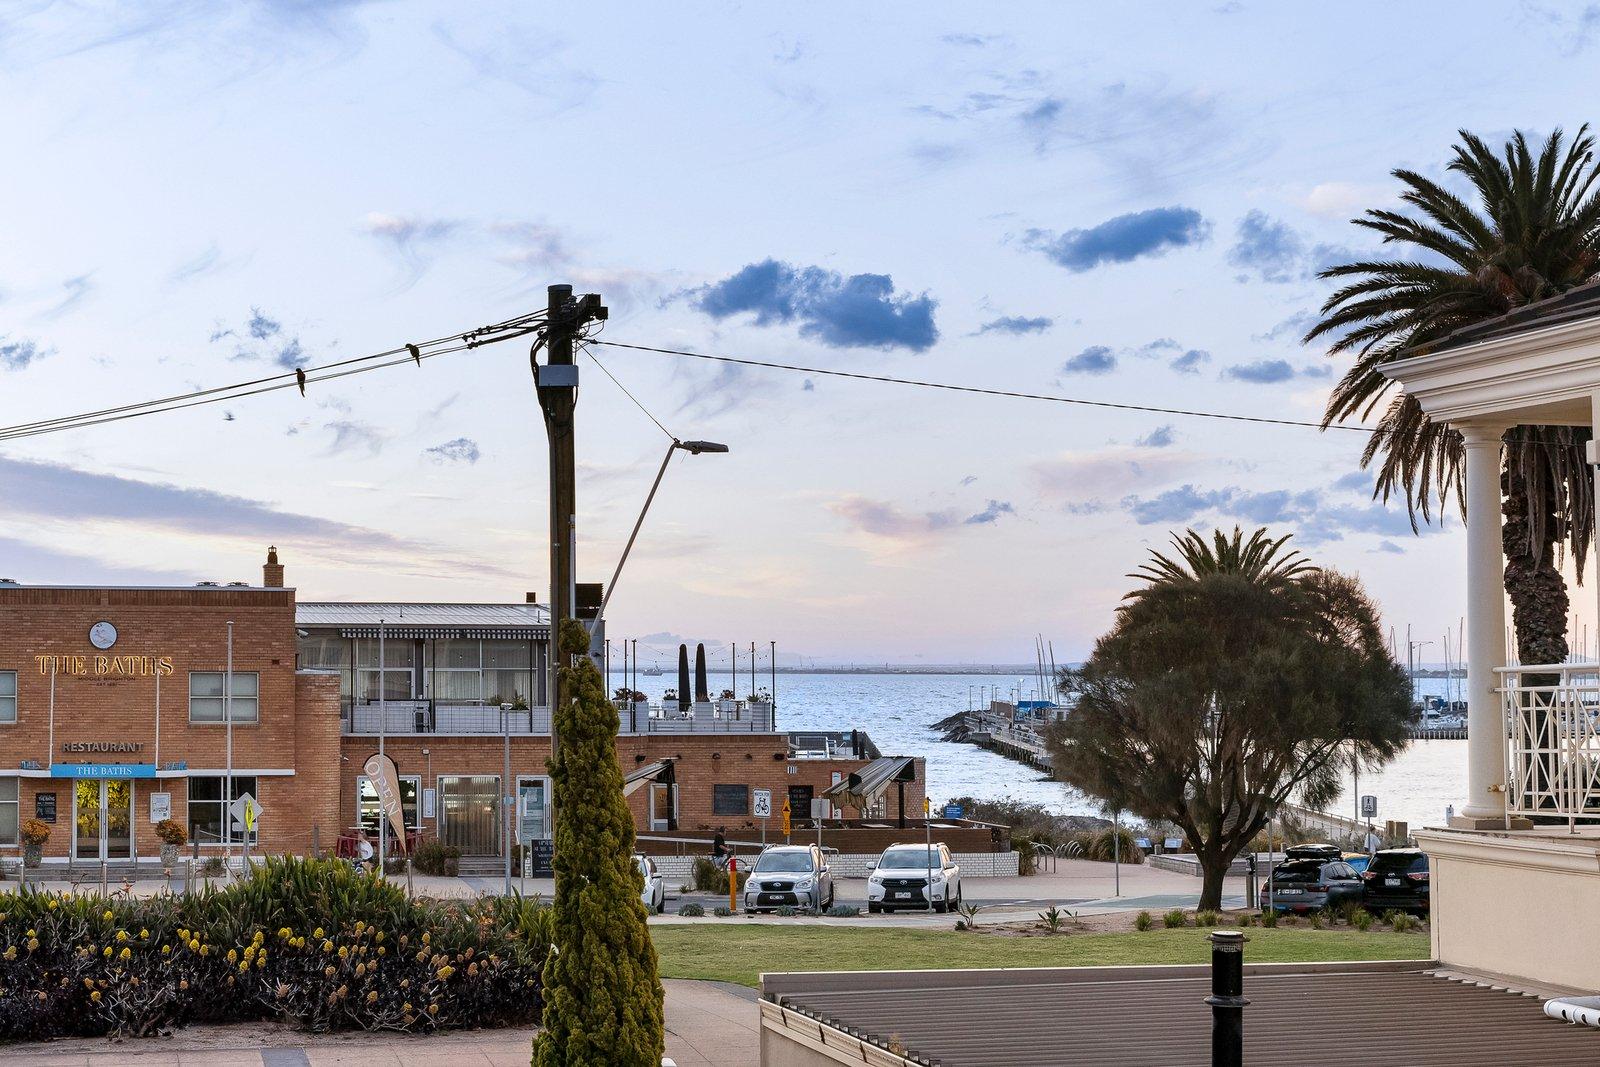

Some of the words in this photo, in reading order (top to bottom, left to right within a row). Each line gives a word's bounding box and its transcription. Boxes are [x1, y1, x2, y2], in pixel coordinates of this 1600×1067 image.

[34, 655, 87, 675] THE
[94, 655, 174, 676] BATHS
[62, 742, 144, 753] RESTAURANT
[76, 766, 98, 776] THE
[101, 766, 133, 776] BATHS
[364, 761, 401, 817] OPEN
